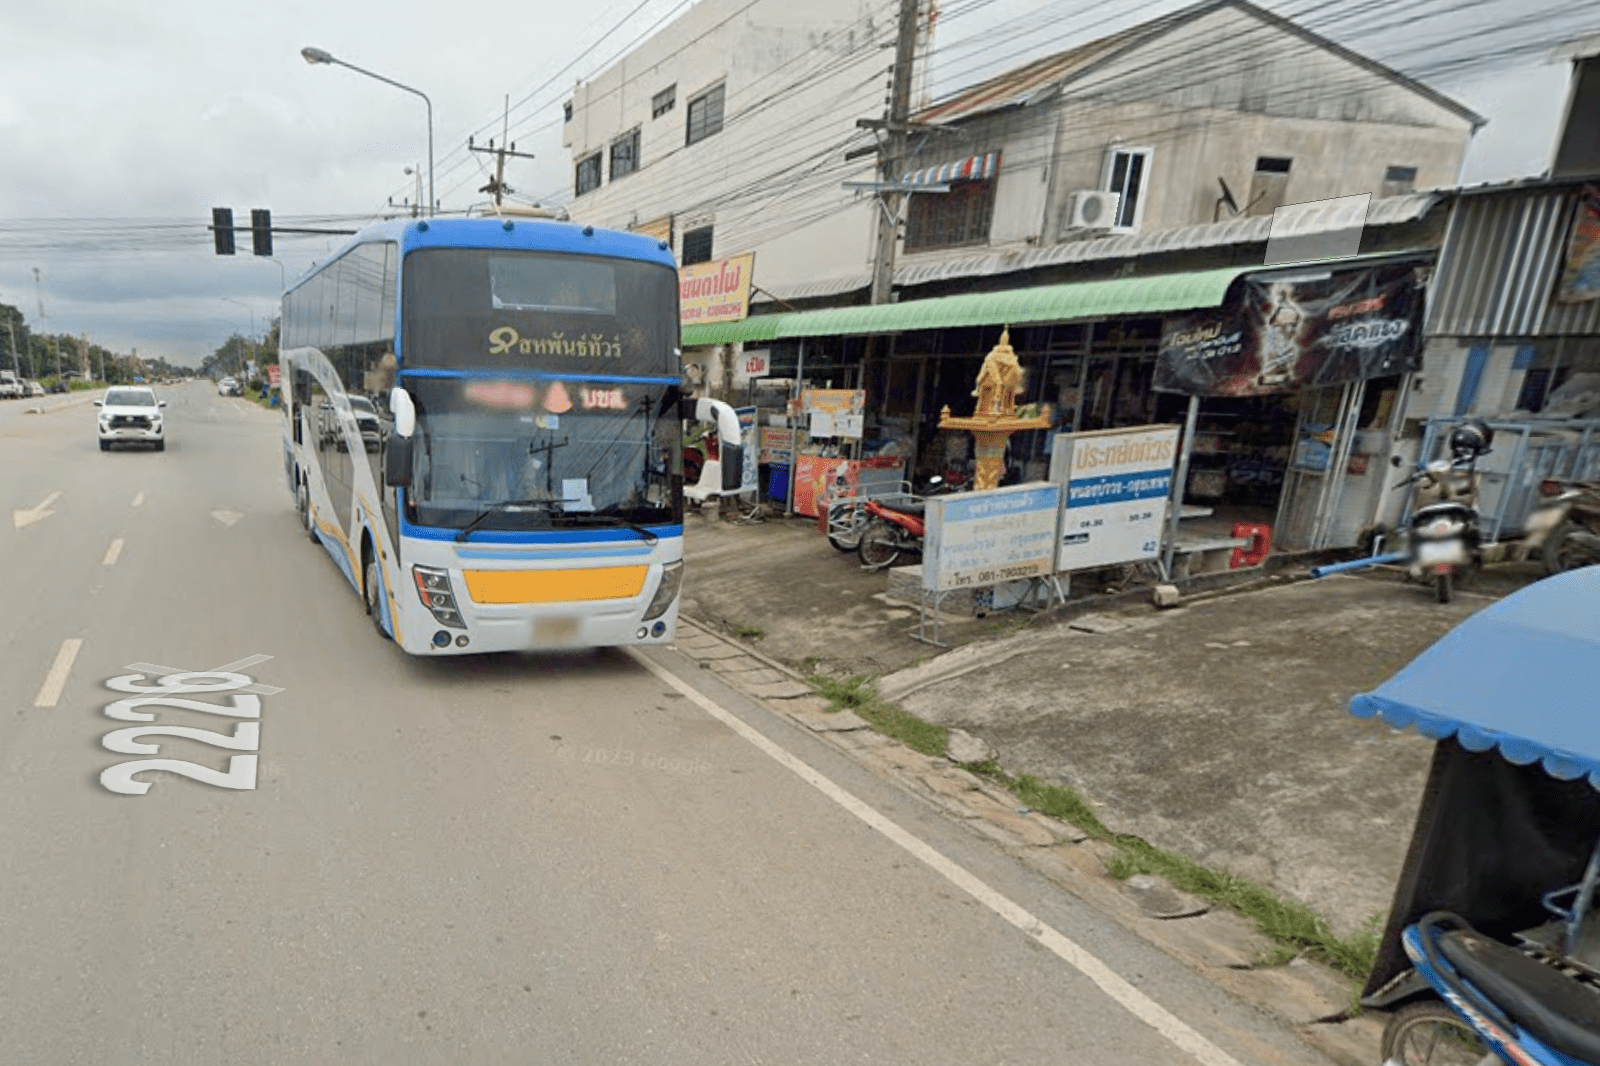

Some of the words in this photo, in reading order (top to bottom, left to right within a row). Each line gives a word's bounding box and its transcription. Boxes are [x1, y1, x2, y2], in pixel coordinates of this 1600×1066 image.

[519, 332, 622, 358] สหพันธ์ทัวร์
